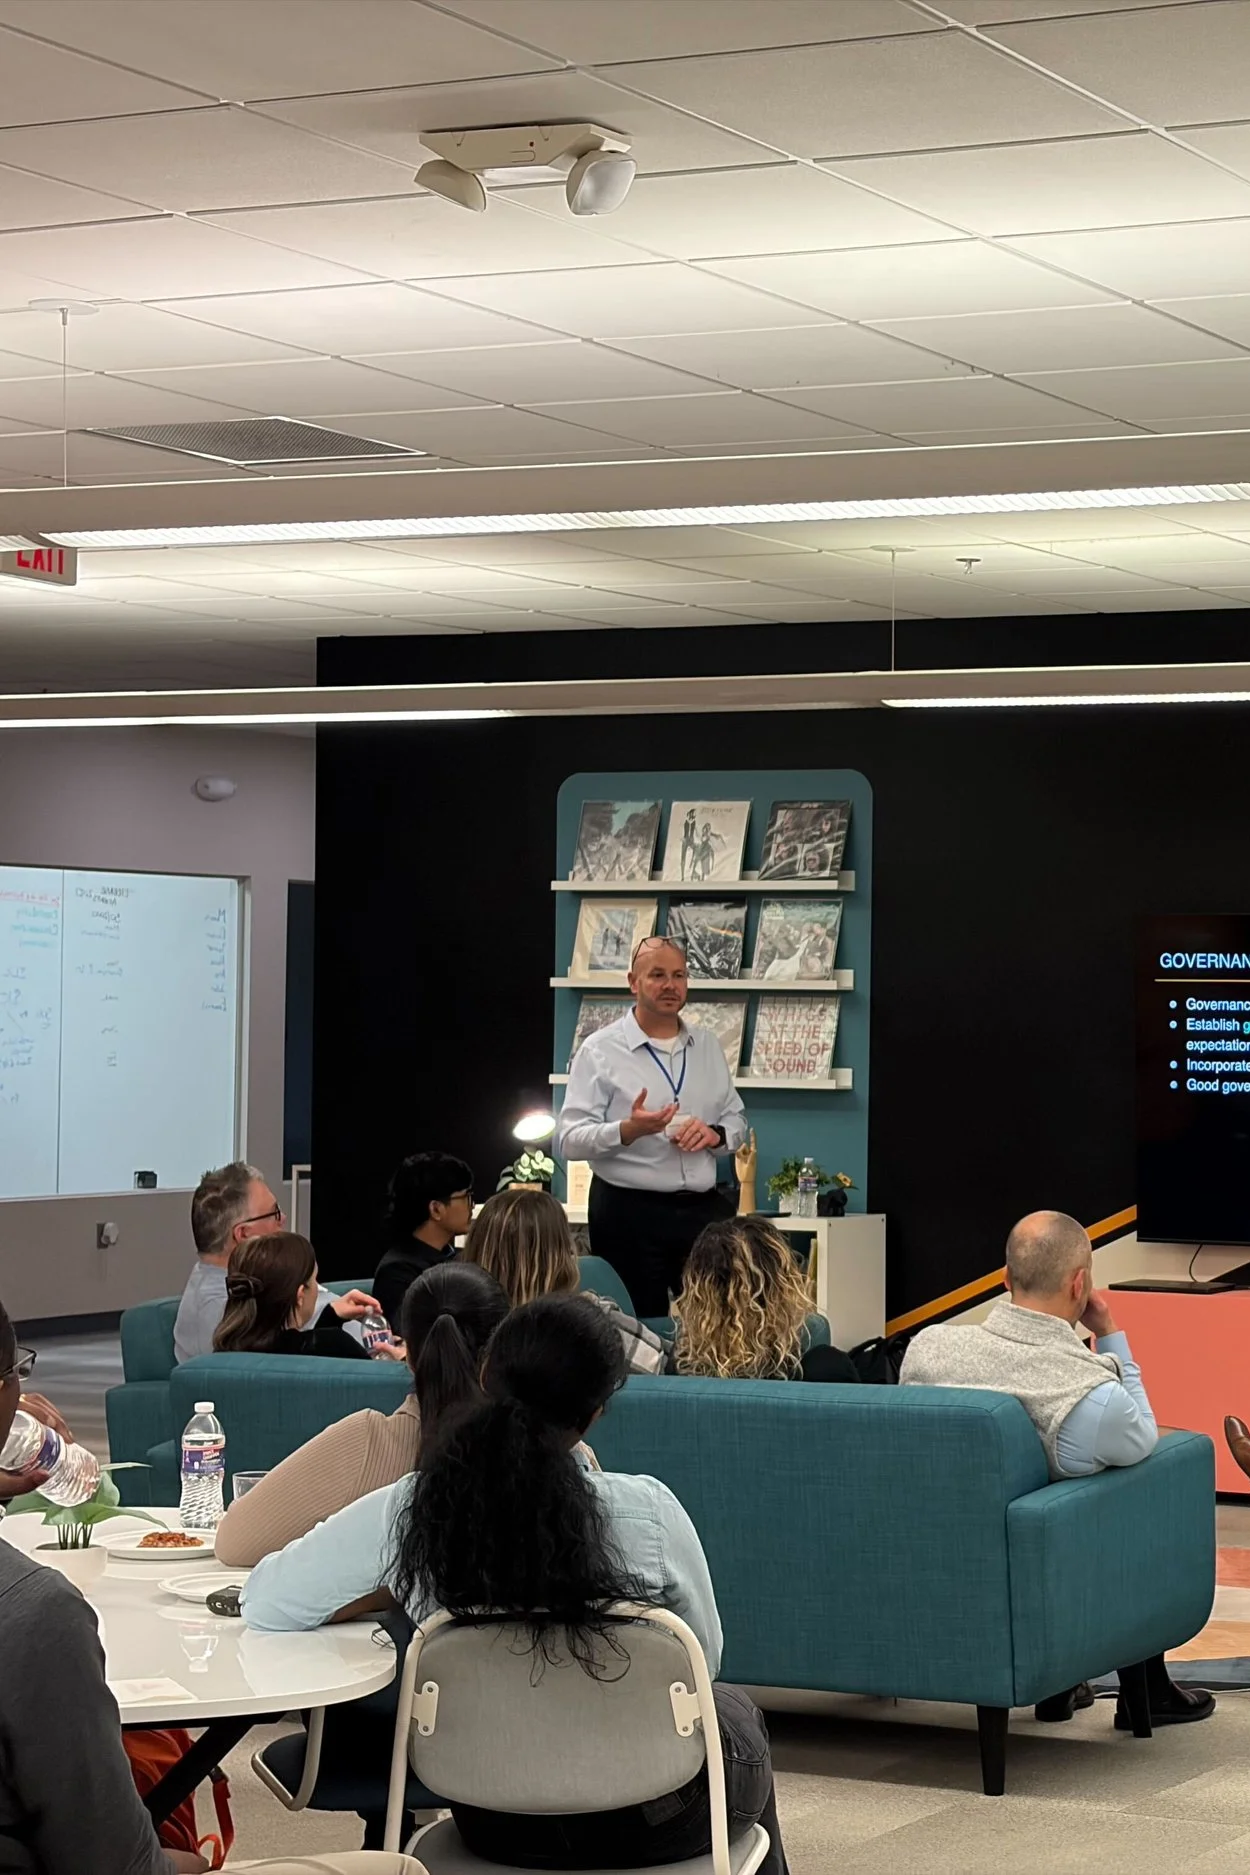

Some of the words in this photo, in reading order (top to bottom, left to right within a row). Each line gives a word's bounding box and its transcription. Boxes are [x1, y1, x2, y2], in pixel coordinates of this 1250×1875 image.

[768, 1024, 788, 1039] AT
[791, 1024, 821, 1039] THE
[1187, 1018, 1240, 1031] Establish
[755, 1041, 803, 1056] SPEED
[808, 1042, 831, 1056] OF
[1187, 1078, 1219, 1091] Good
